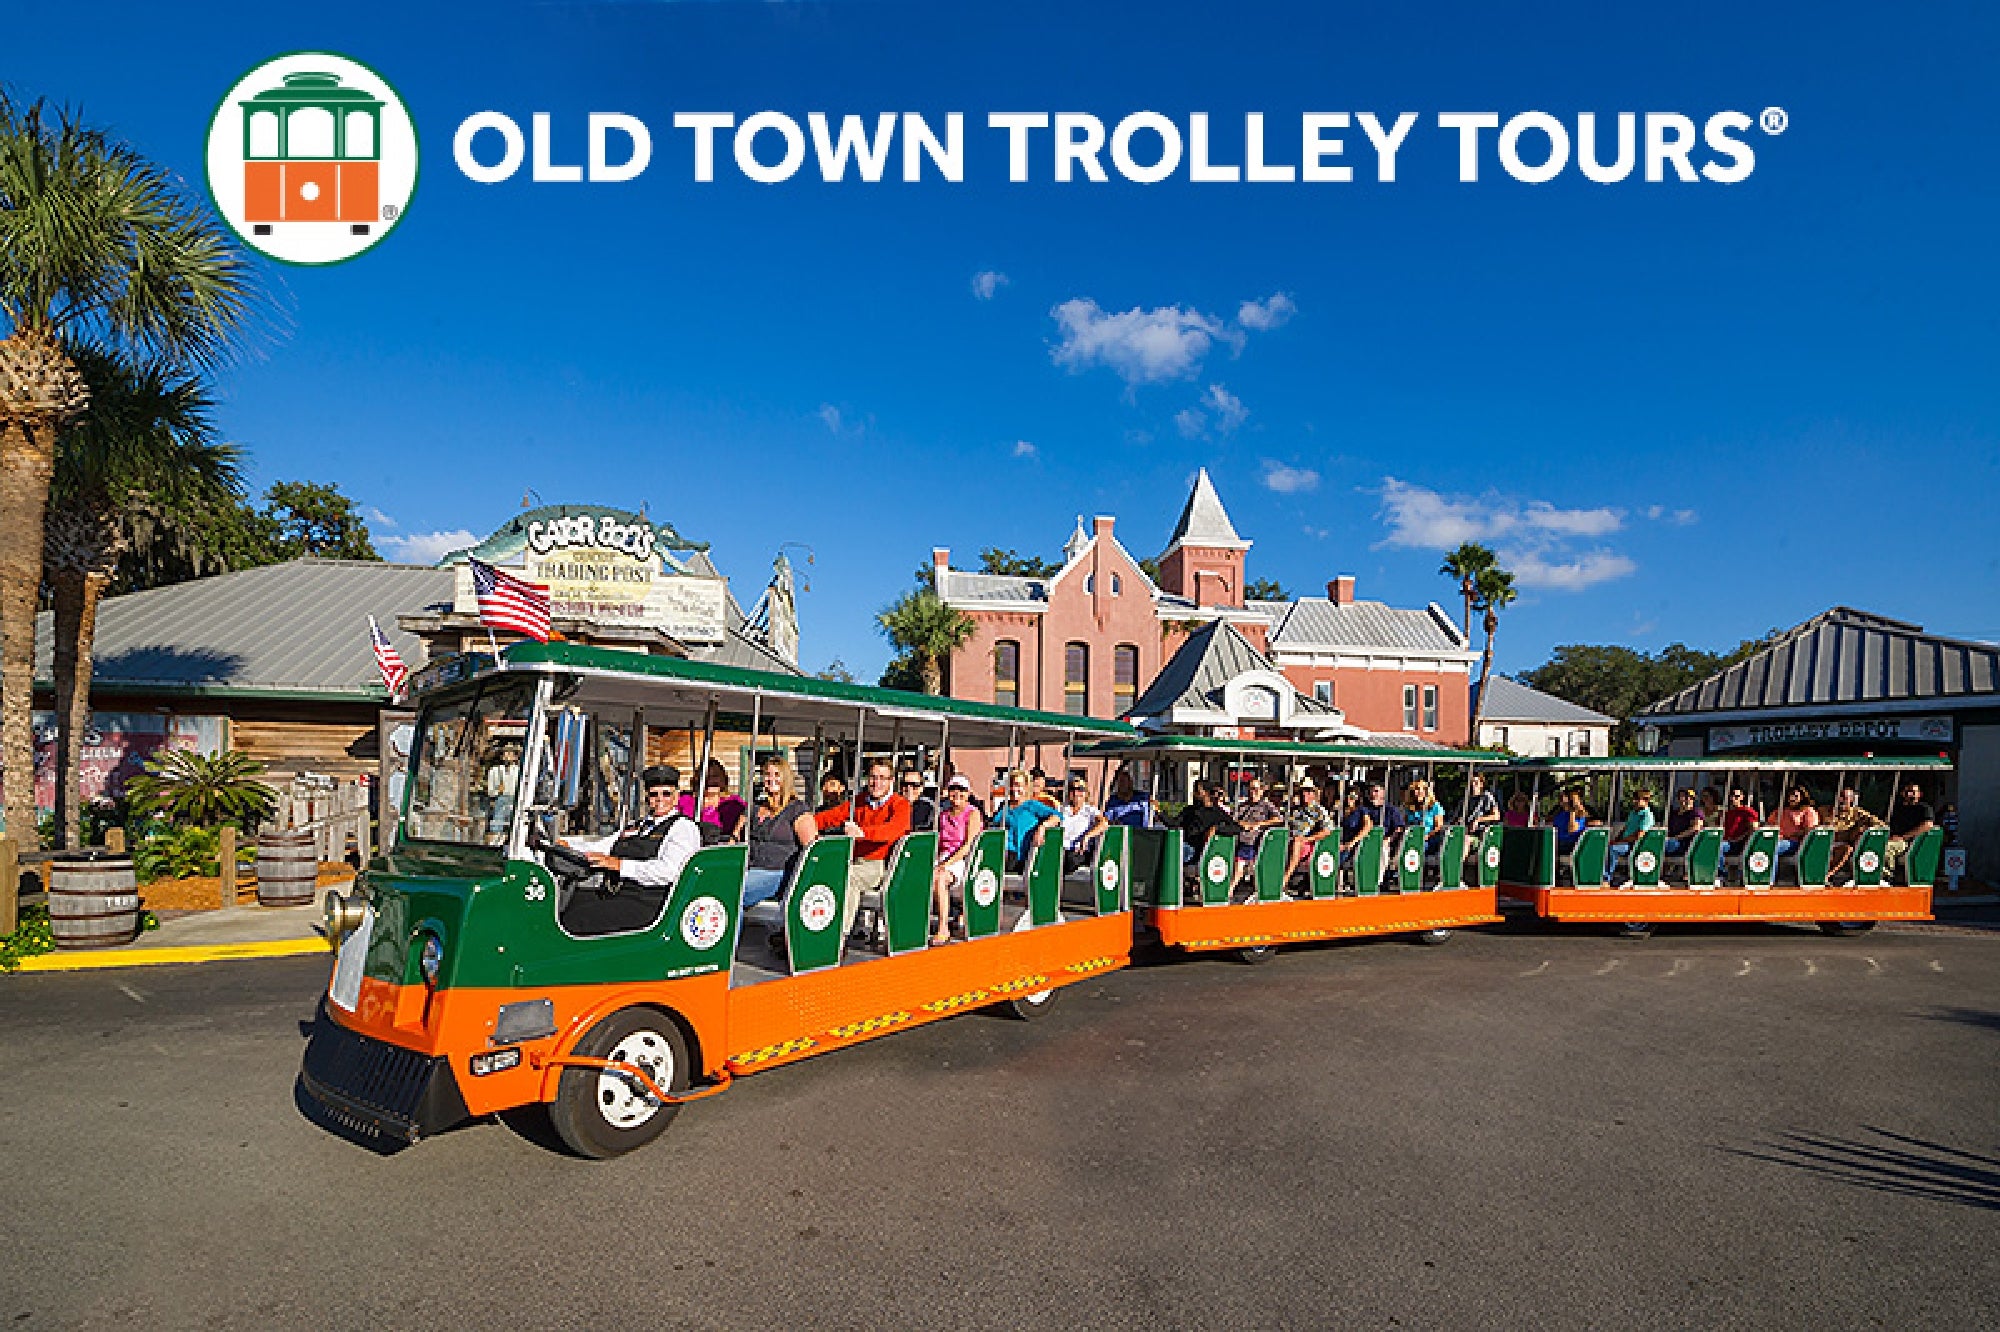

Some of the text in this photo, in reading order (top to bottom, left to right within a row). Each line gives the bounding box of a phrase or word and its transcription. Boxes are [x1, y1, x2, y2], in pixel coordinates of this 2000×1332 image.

[536, 562, 652, 583] TRADING POST
[1749, 719, 1901, 743] TROLLEY DEPOT
